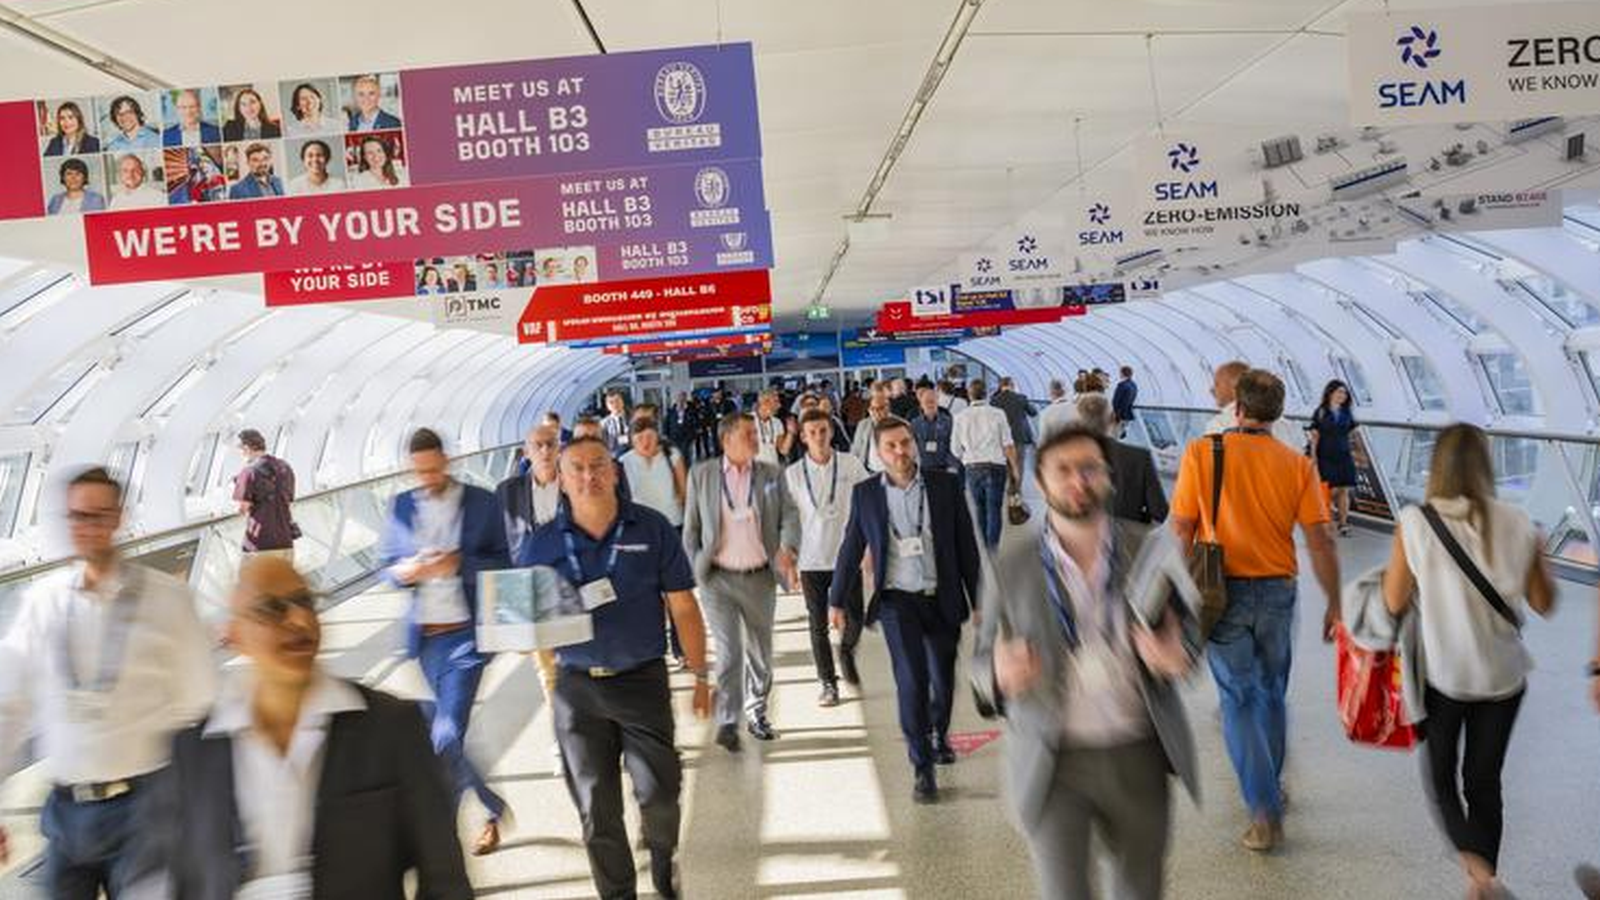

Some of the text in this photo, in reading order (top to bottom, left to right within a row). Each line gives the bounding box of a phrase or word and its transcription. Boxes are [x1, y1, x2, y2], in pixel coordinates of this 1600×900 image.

[453, 78, 584, 103] MEET US AT
[1509, 74, 1598, 92] WE KNOW
[1378, 80, 1466, 108] SEAM
[456, 105, 588, 138] HALL B3
[458, 132, 590, 161] BOOTH 103
[560, 177, 648, 195] MEET US AT
[1155, 181, 1218, 201] SEAM
[562, 195, 651, 218] HALL B3
[113, 199, 522, 259] WE'RE BY YOUR SIDE
[564, 214, 652, 233] BOOTH 103
[1078, 230, 1123, 245] SEAM
[621, 241, 688, 258] HALL B3
[622, 254, 689, 270] BOOTH 103
[1008, 258, 1049, 272] SEAM
[290, 270, 390, 292] YOUR SIDE
[467, 297, 501, 311] TMC
[583, 293, 628, 305] BOOTH
[664, 286, 697, 298] HALL
